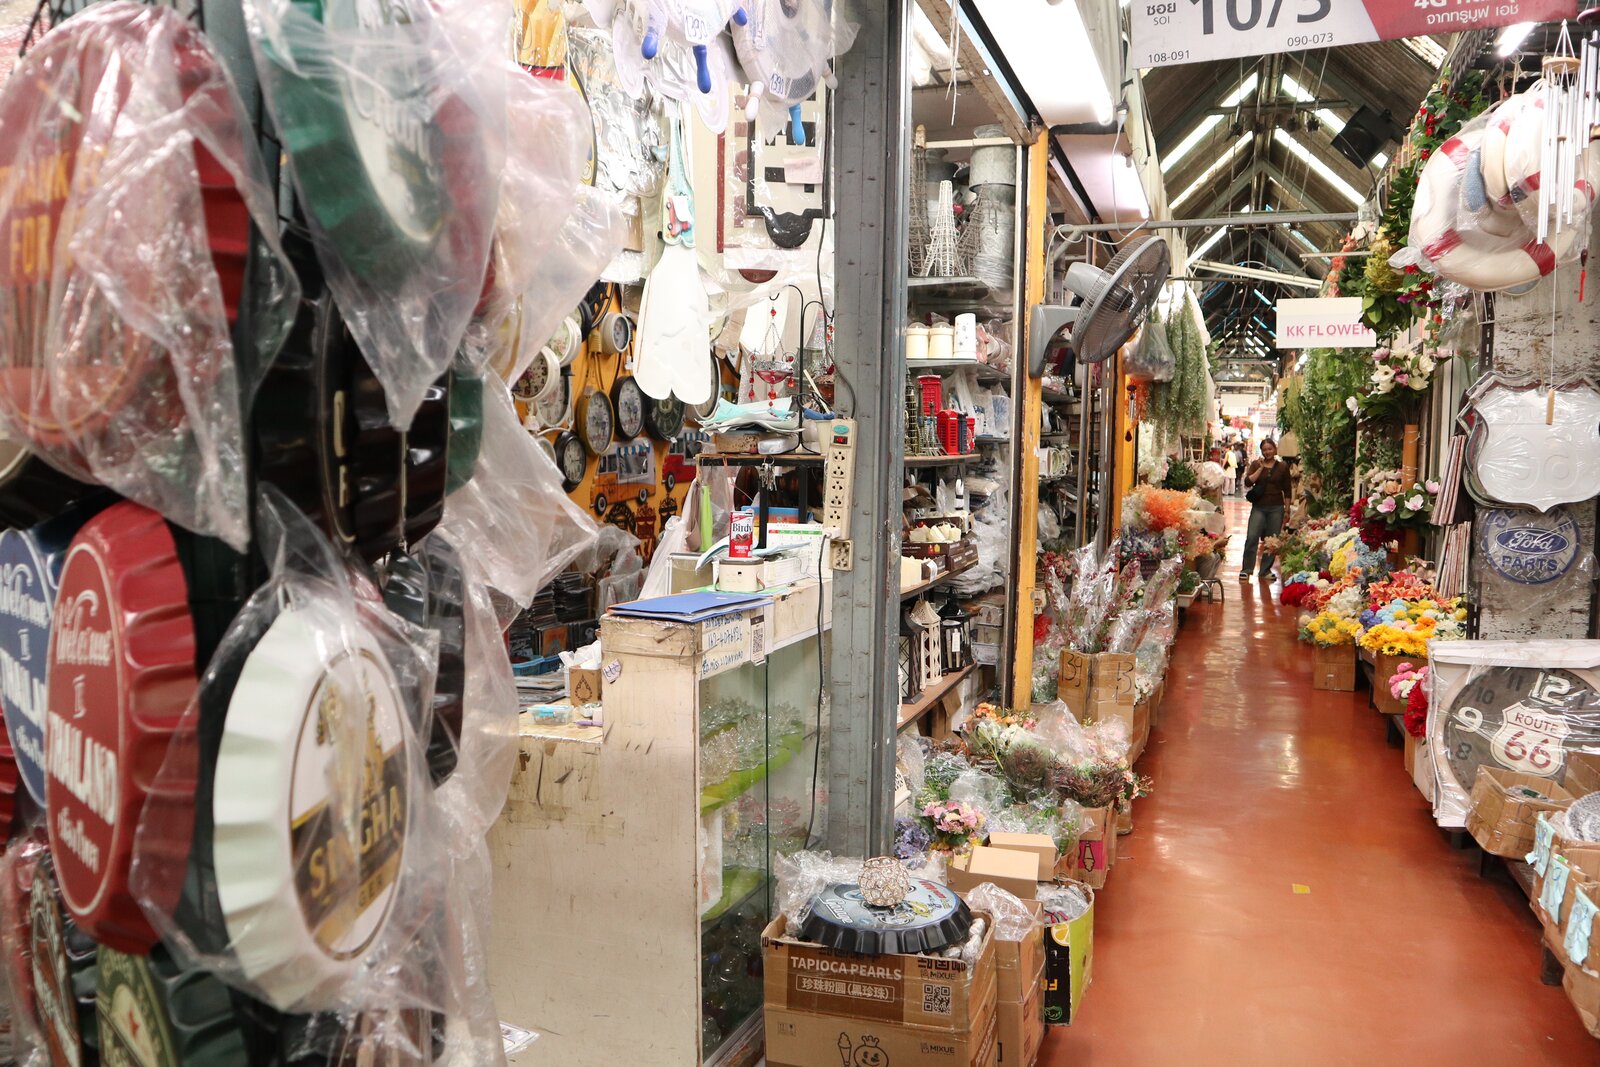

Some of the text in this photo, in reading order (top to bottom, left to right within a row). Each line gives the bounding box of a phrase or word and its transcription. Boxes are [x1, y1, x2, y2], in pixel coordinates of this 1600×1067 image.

[1153, 16, 1170, 26] SOI
[1287, 32, 1334, 47] 090-073
[1148, 50, 1190, 64] 108-091
[1286, 325, 1304, 337] KK
[1508, 530, 1554, 551] Ford
[1502, 555, 1558, 571] PARTS
[1506, 673, 1524, 691] 11
[1529, 672, 1571, 706] 12
[1476, 686, 1494, 705] 10
[1454, 707, 1483, 733] 9
[1514, 711, 1559, 735] ROUTE
[1455, 741, 1472, 760] 8
[1504, 731, 1552, 769] 66
[790, 956, 848, 975] TAPIOCA
[850, 963, 902, 981] PEARLS
[930, 971, 956, 980] MIXUE
[930, 1044, 955, 1054] MIXUE
